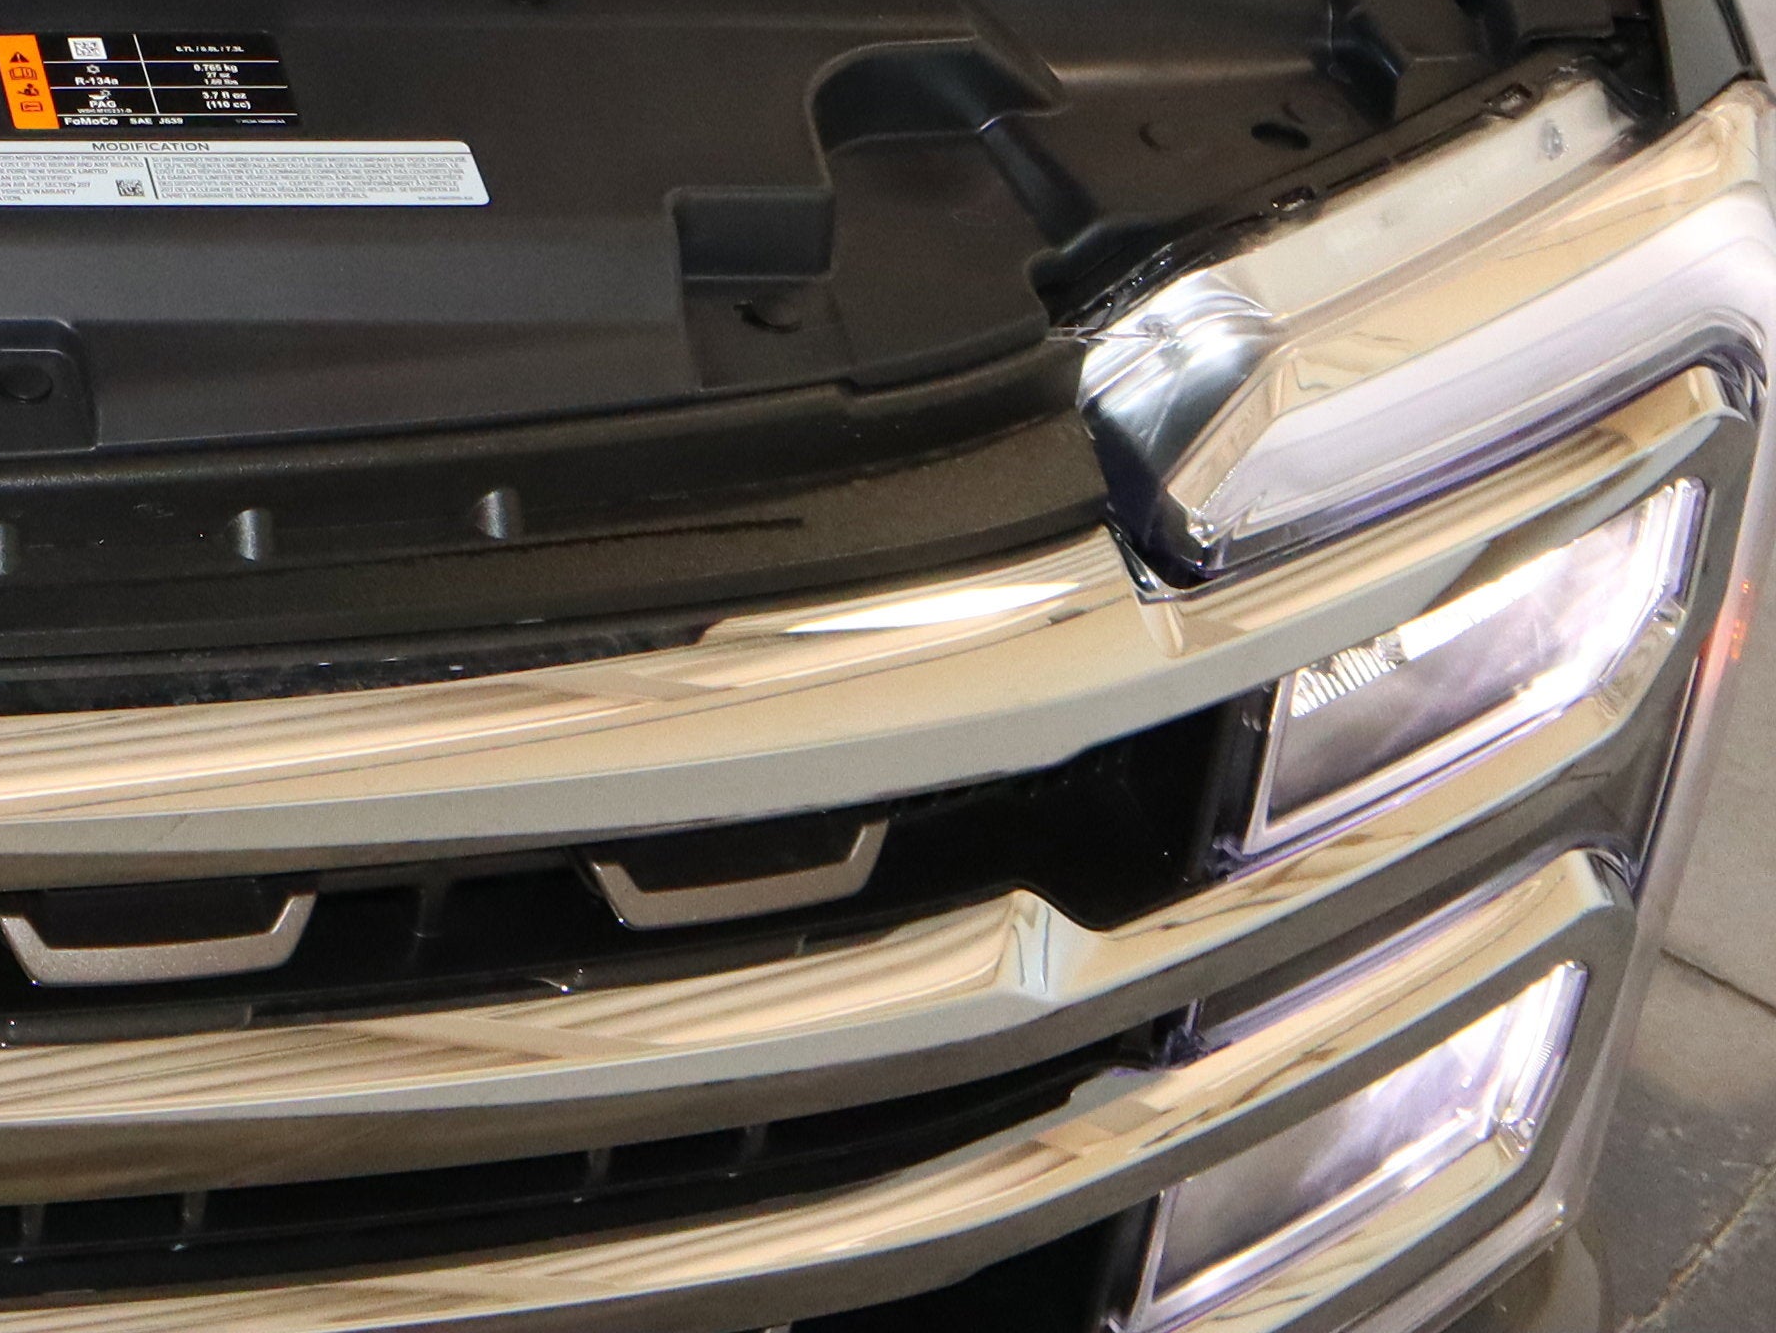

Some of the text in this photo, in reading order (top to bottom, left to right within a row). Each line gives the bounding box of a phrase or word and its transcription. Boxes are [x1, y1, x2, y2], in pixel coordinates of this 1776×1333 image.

[194, 64, 238, 74] 0.765 kg
[74, 77, 119, 86] R-134a
[202, 91, 220, 99] 3.7
[235, 92, 247, 100] oz
[89, 100, 117, 109] PAG
[206, 100, 251, 110] (110 cc)
[64, 117, 184, 126] FoMoCo SAE J639
[91, 142, 211, 151] MODIFICATION
